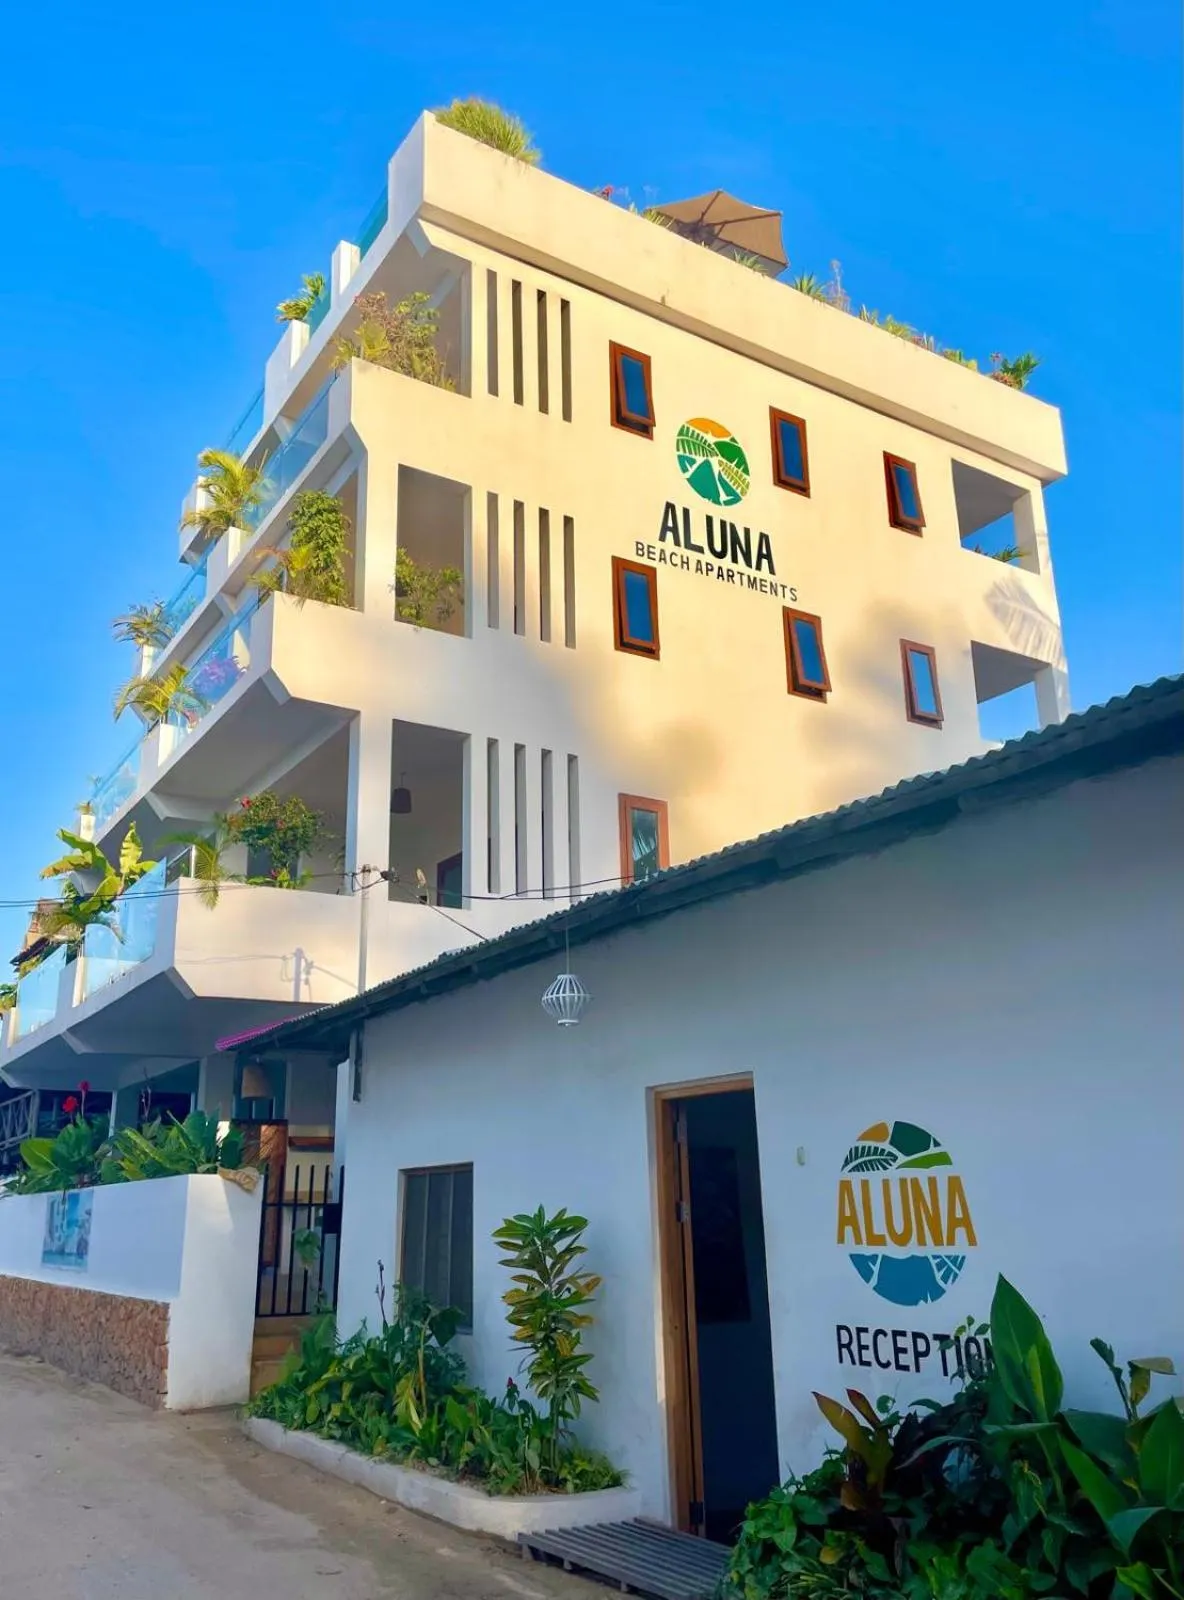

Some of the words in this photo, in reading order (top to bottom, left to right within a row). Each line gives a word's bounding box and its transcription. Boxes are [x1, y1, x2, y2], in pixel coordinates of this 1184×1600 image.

[635, 541, 690, 571] BEACH
[695, 559, 798, 602] APARTMENTS
[658, 501, 776, 575] ALUNA
[837, 1175, 977, 1247] ALUNA
